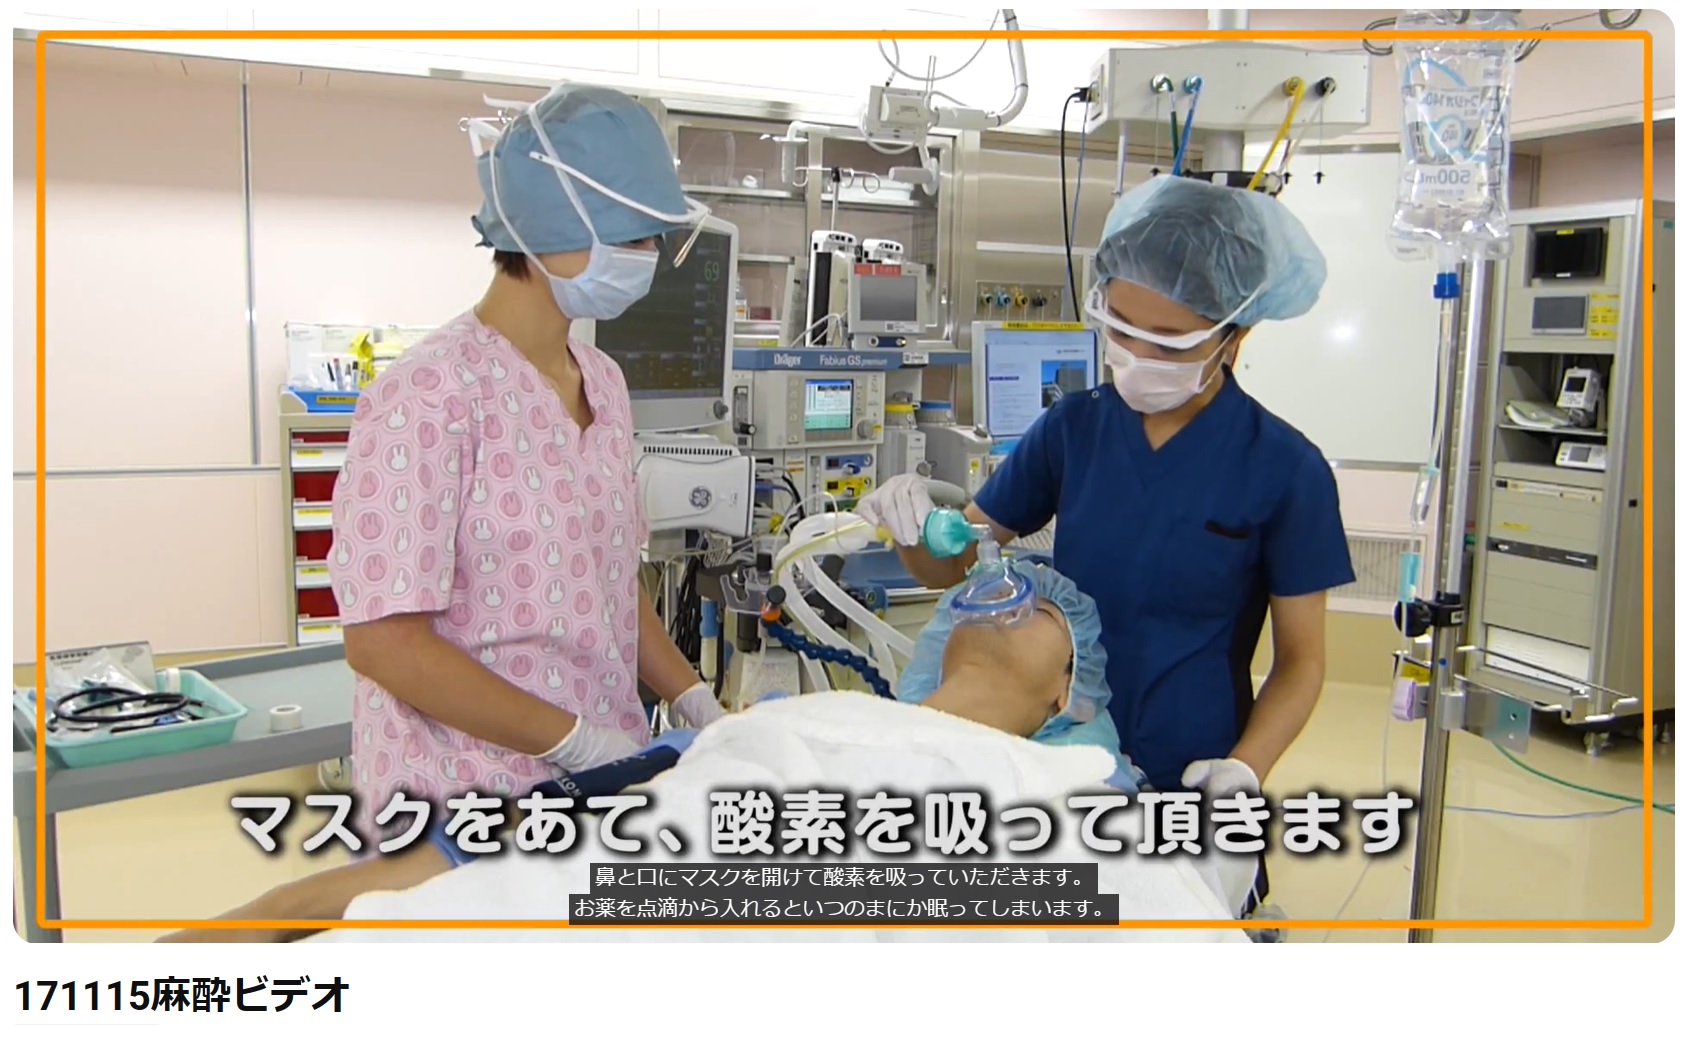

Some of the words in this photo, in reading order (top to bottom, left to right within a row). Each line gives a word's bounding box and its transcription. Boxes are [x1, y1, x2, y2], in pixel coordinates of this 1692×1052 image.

[704, 261, 720, 282] 69
[819, 354, 846, 367] Fabius
[847, 354, 861, 367] GS
